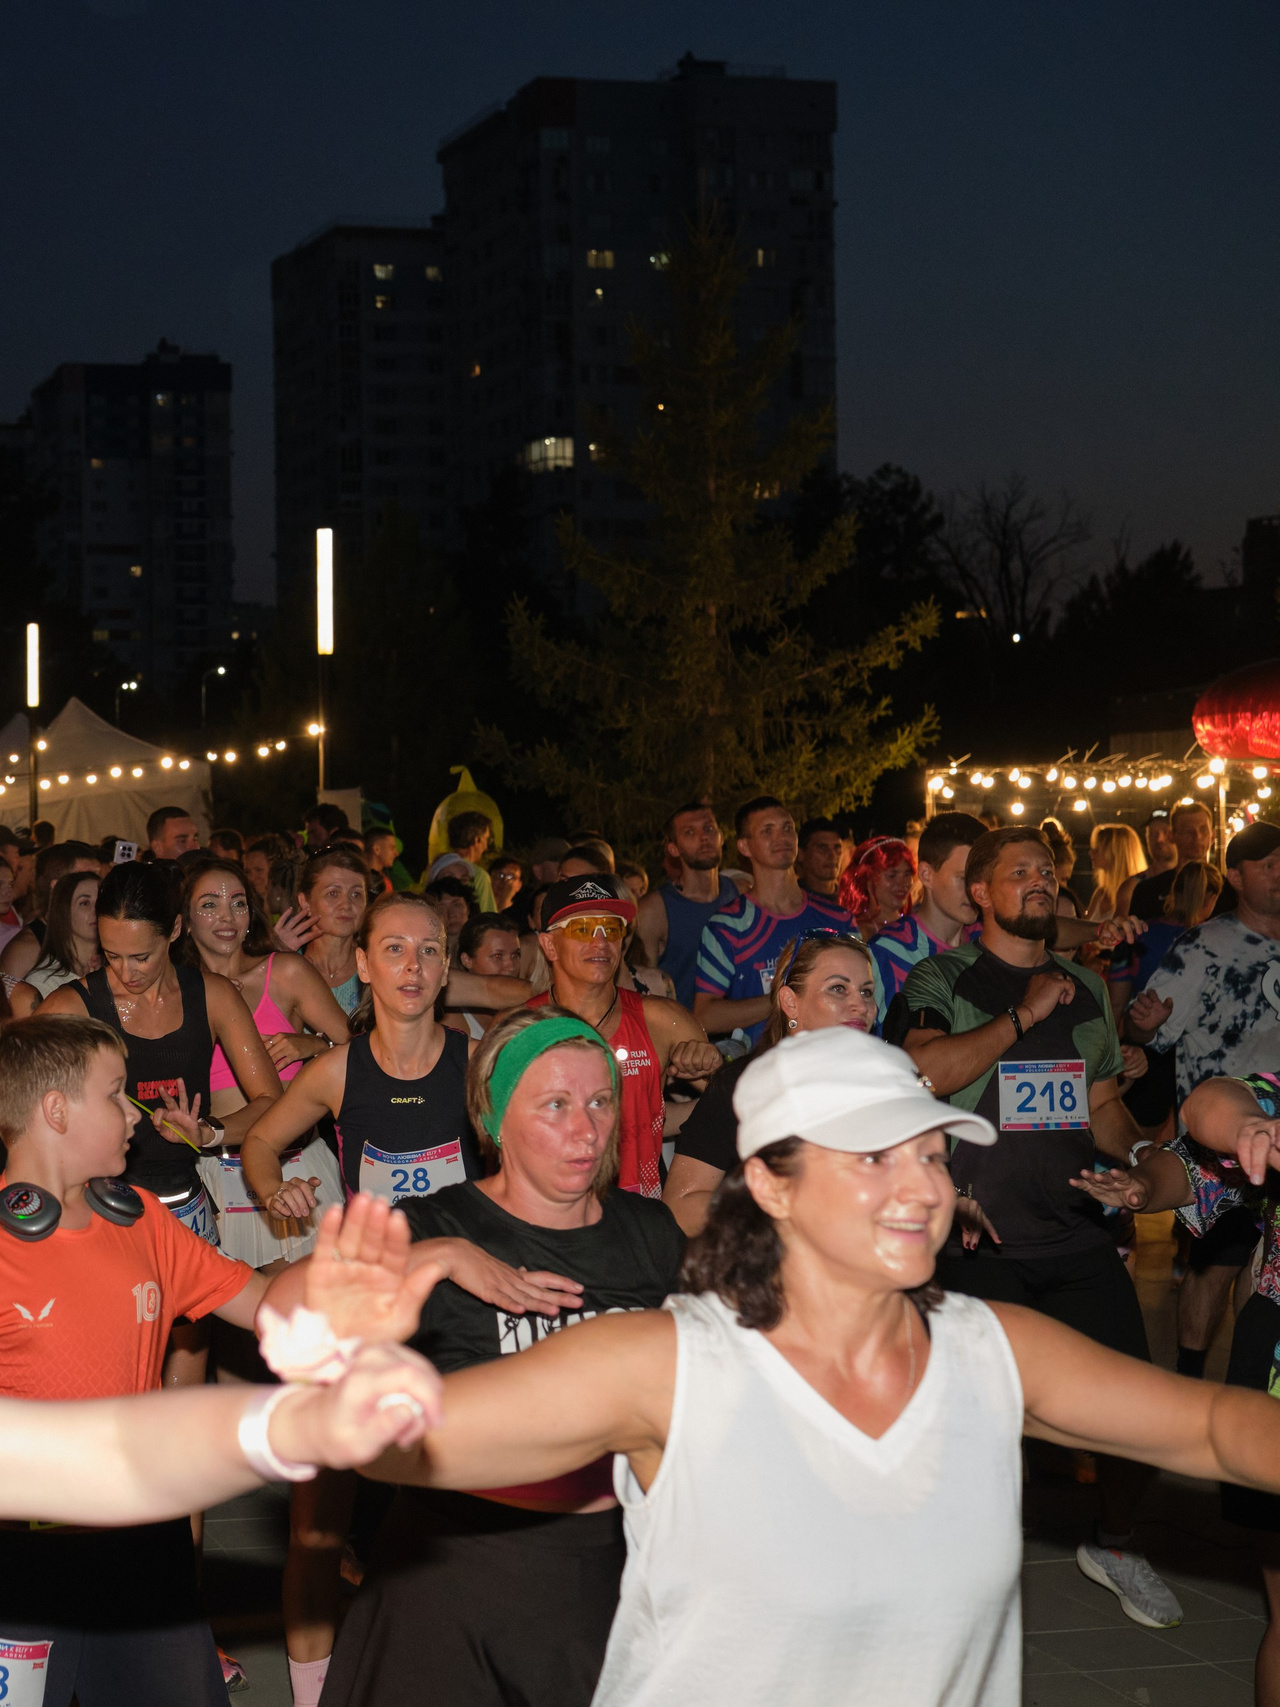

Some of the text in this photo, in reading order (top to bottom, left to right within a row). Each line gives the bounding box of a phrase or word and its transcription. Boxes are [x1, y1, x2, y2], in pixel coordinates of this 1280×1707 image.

[630, 1050, 647, 1058] RUN
[1016, 1080, 1077, 1113] 218
[391, 1167, 431, 1193] 28
[131, 1281, 162, 1325] 10
